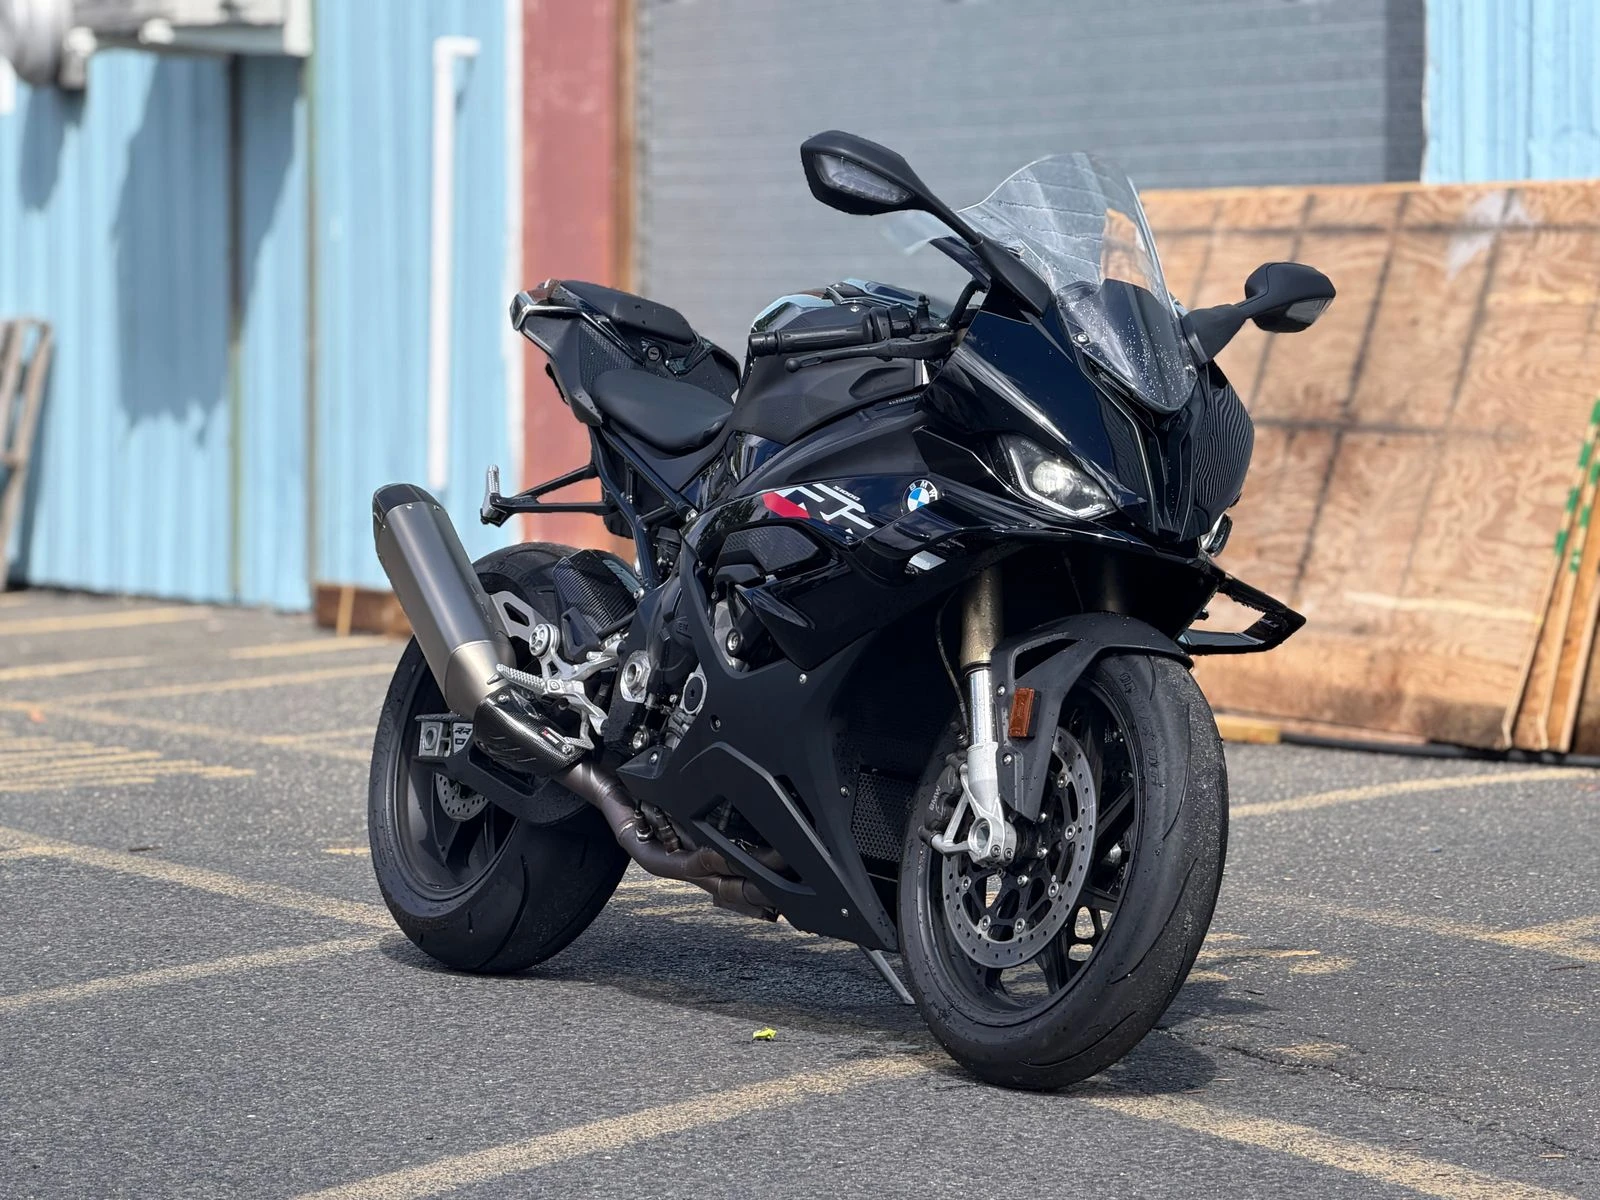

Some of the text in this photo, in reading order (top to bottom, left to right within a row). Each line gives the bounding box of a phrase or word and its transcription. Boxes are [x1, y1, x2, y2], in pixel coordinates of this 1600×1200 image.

[833, 485, 861, 501] S1000
[909, 480, 938, 501] BMW
[454, 726, 472, 735] RR
